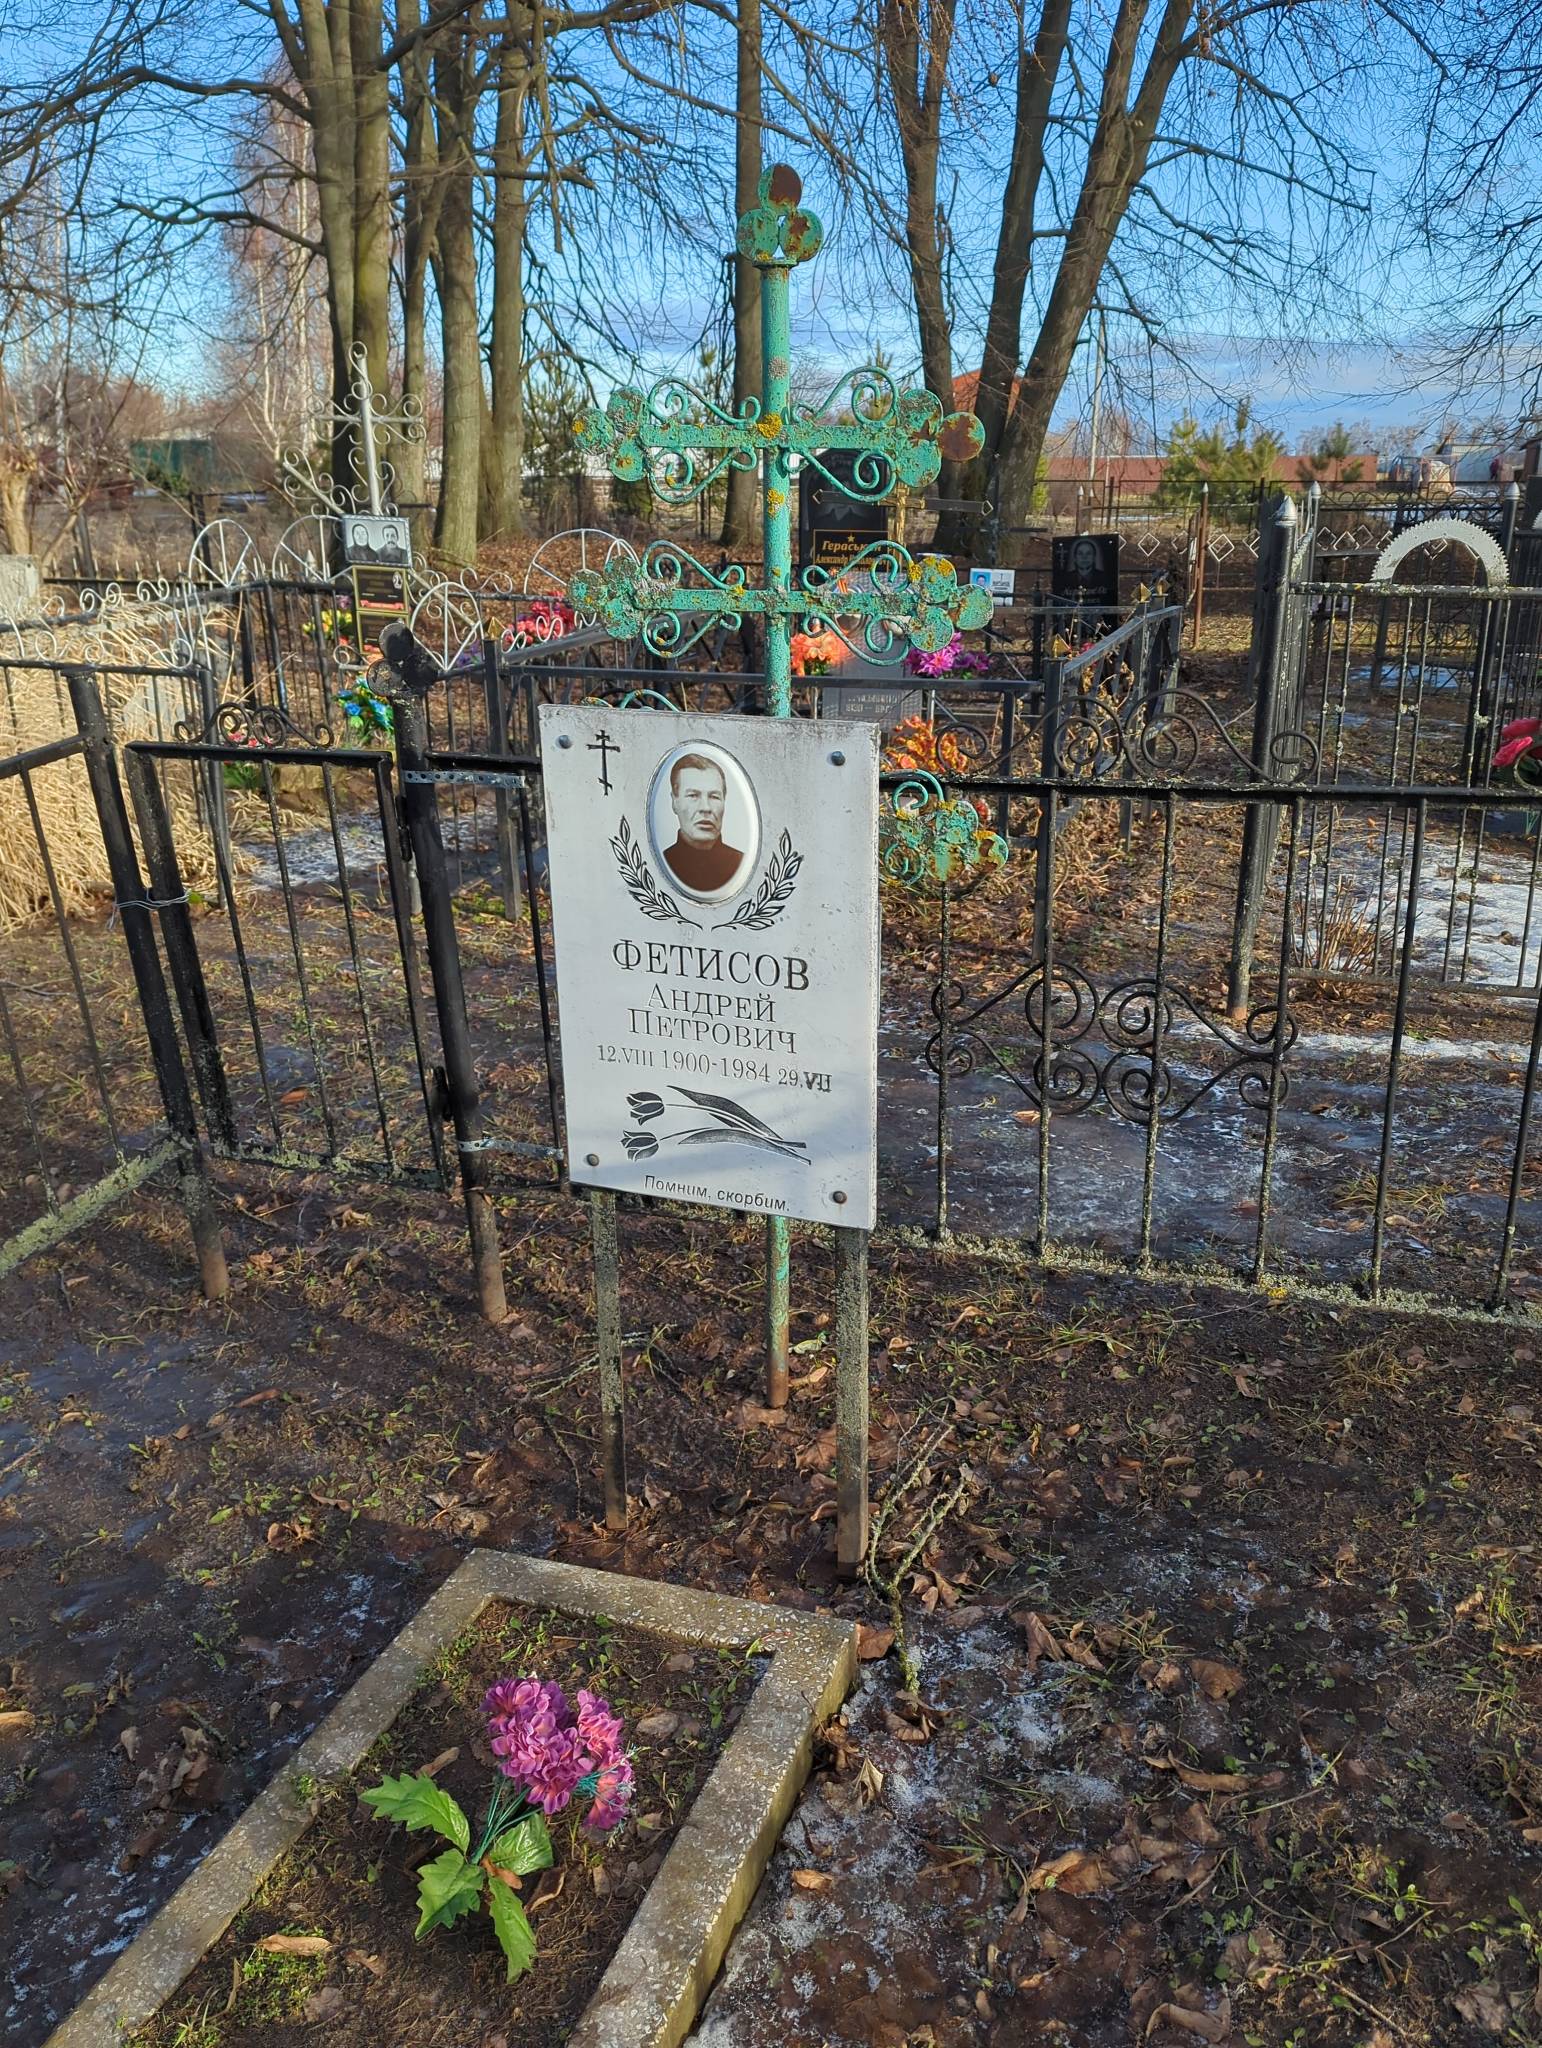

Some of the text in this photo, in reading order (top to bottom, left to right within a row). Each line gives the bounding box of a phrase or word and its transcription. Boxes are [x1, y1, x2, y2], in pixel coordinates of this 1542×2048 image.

[822, 540, 882, 553] Гераськн
[612, 939, 810, 991] ФЕТИСОВ
[649, 982, 777, 1023] АНДРЕЙ
[627, 1008, 798, 1055] ПЕТРОВИЧ
[597, 1044, 833, 1093] 12.VIII 1900-1984 29.VII
[644, 1175, 790, 1212] Помним, скорбим.
